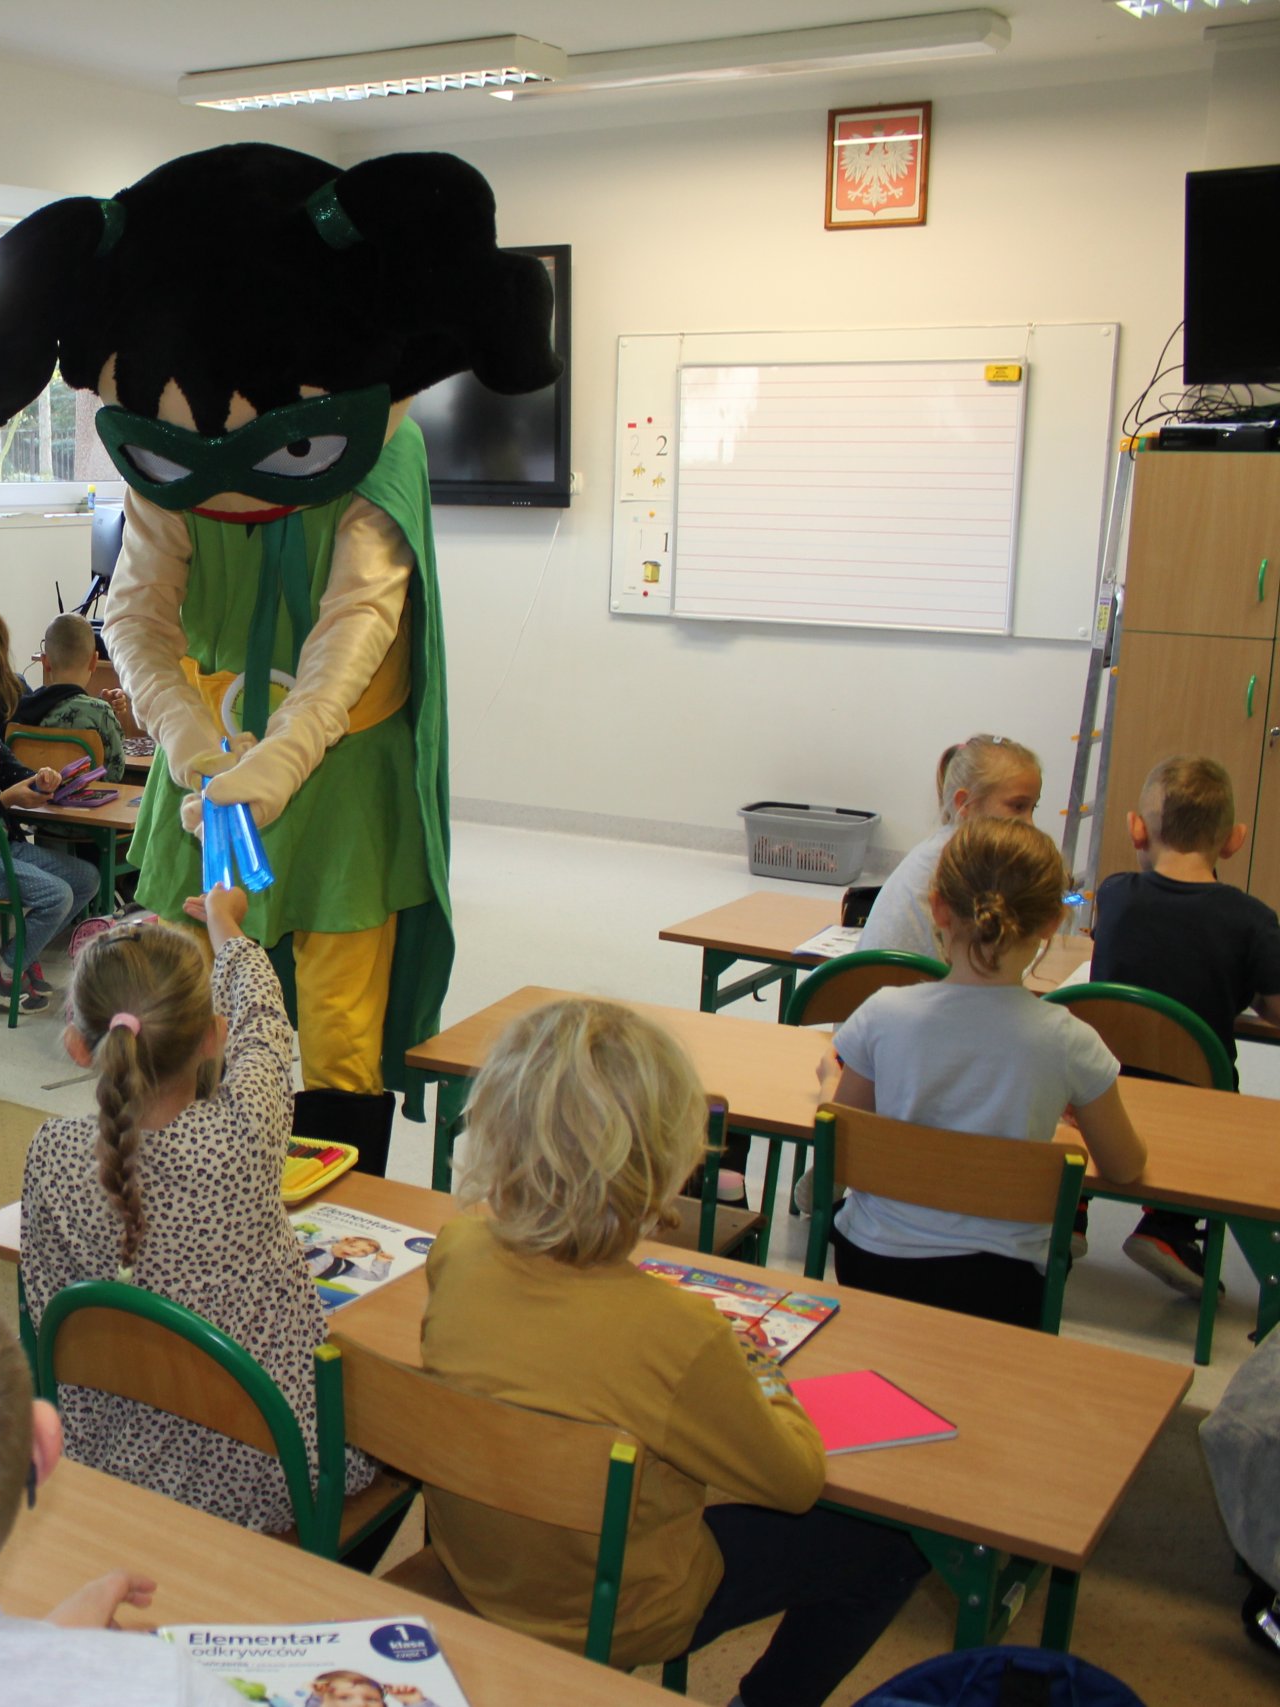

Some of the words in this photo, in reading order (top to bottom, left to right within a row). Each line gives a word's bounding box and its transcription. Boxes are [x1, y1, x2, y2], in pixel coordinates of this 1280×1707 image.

[656, 435, 668, 456] 2
[188, 1632, 341, 1646] Elementarz
[394, 1625, 410, 1641] 1
[191, 1646, 308, 1660] odkrywców
